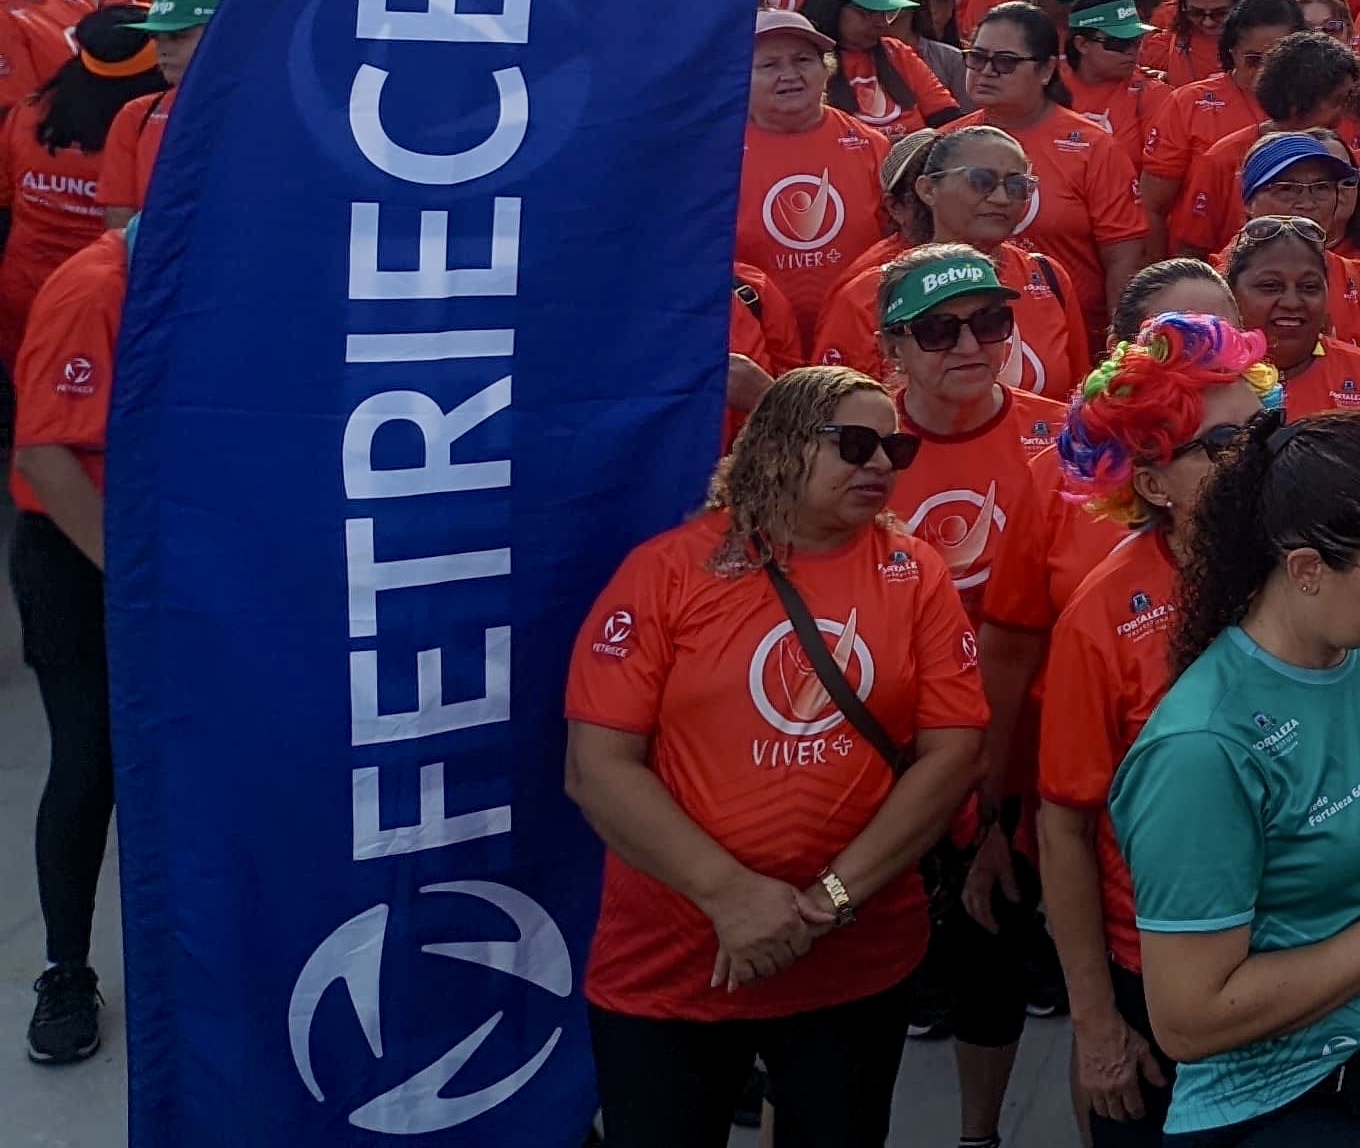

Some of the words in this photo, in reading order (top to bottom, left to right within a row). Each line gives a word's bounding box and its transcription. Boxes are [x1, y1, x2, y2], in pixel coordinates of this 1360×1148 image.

[775, 252, 824, 270] VIVER
[922, 264, 984, 294] Betvip
[752, 738, 828, 768] VIVER
[1309, 796, 1353, 827] Fortaleza
